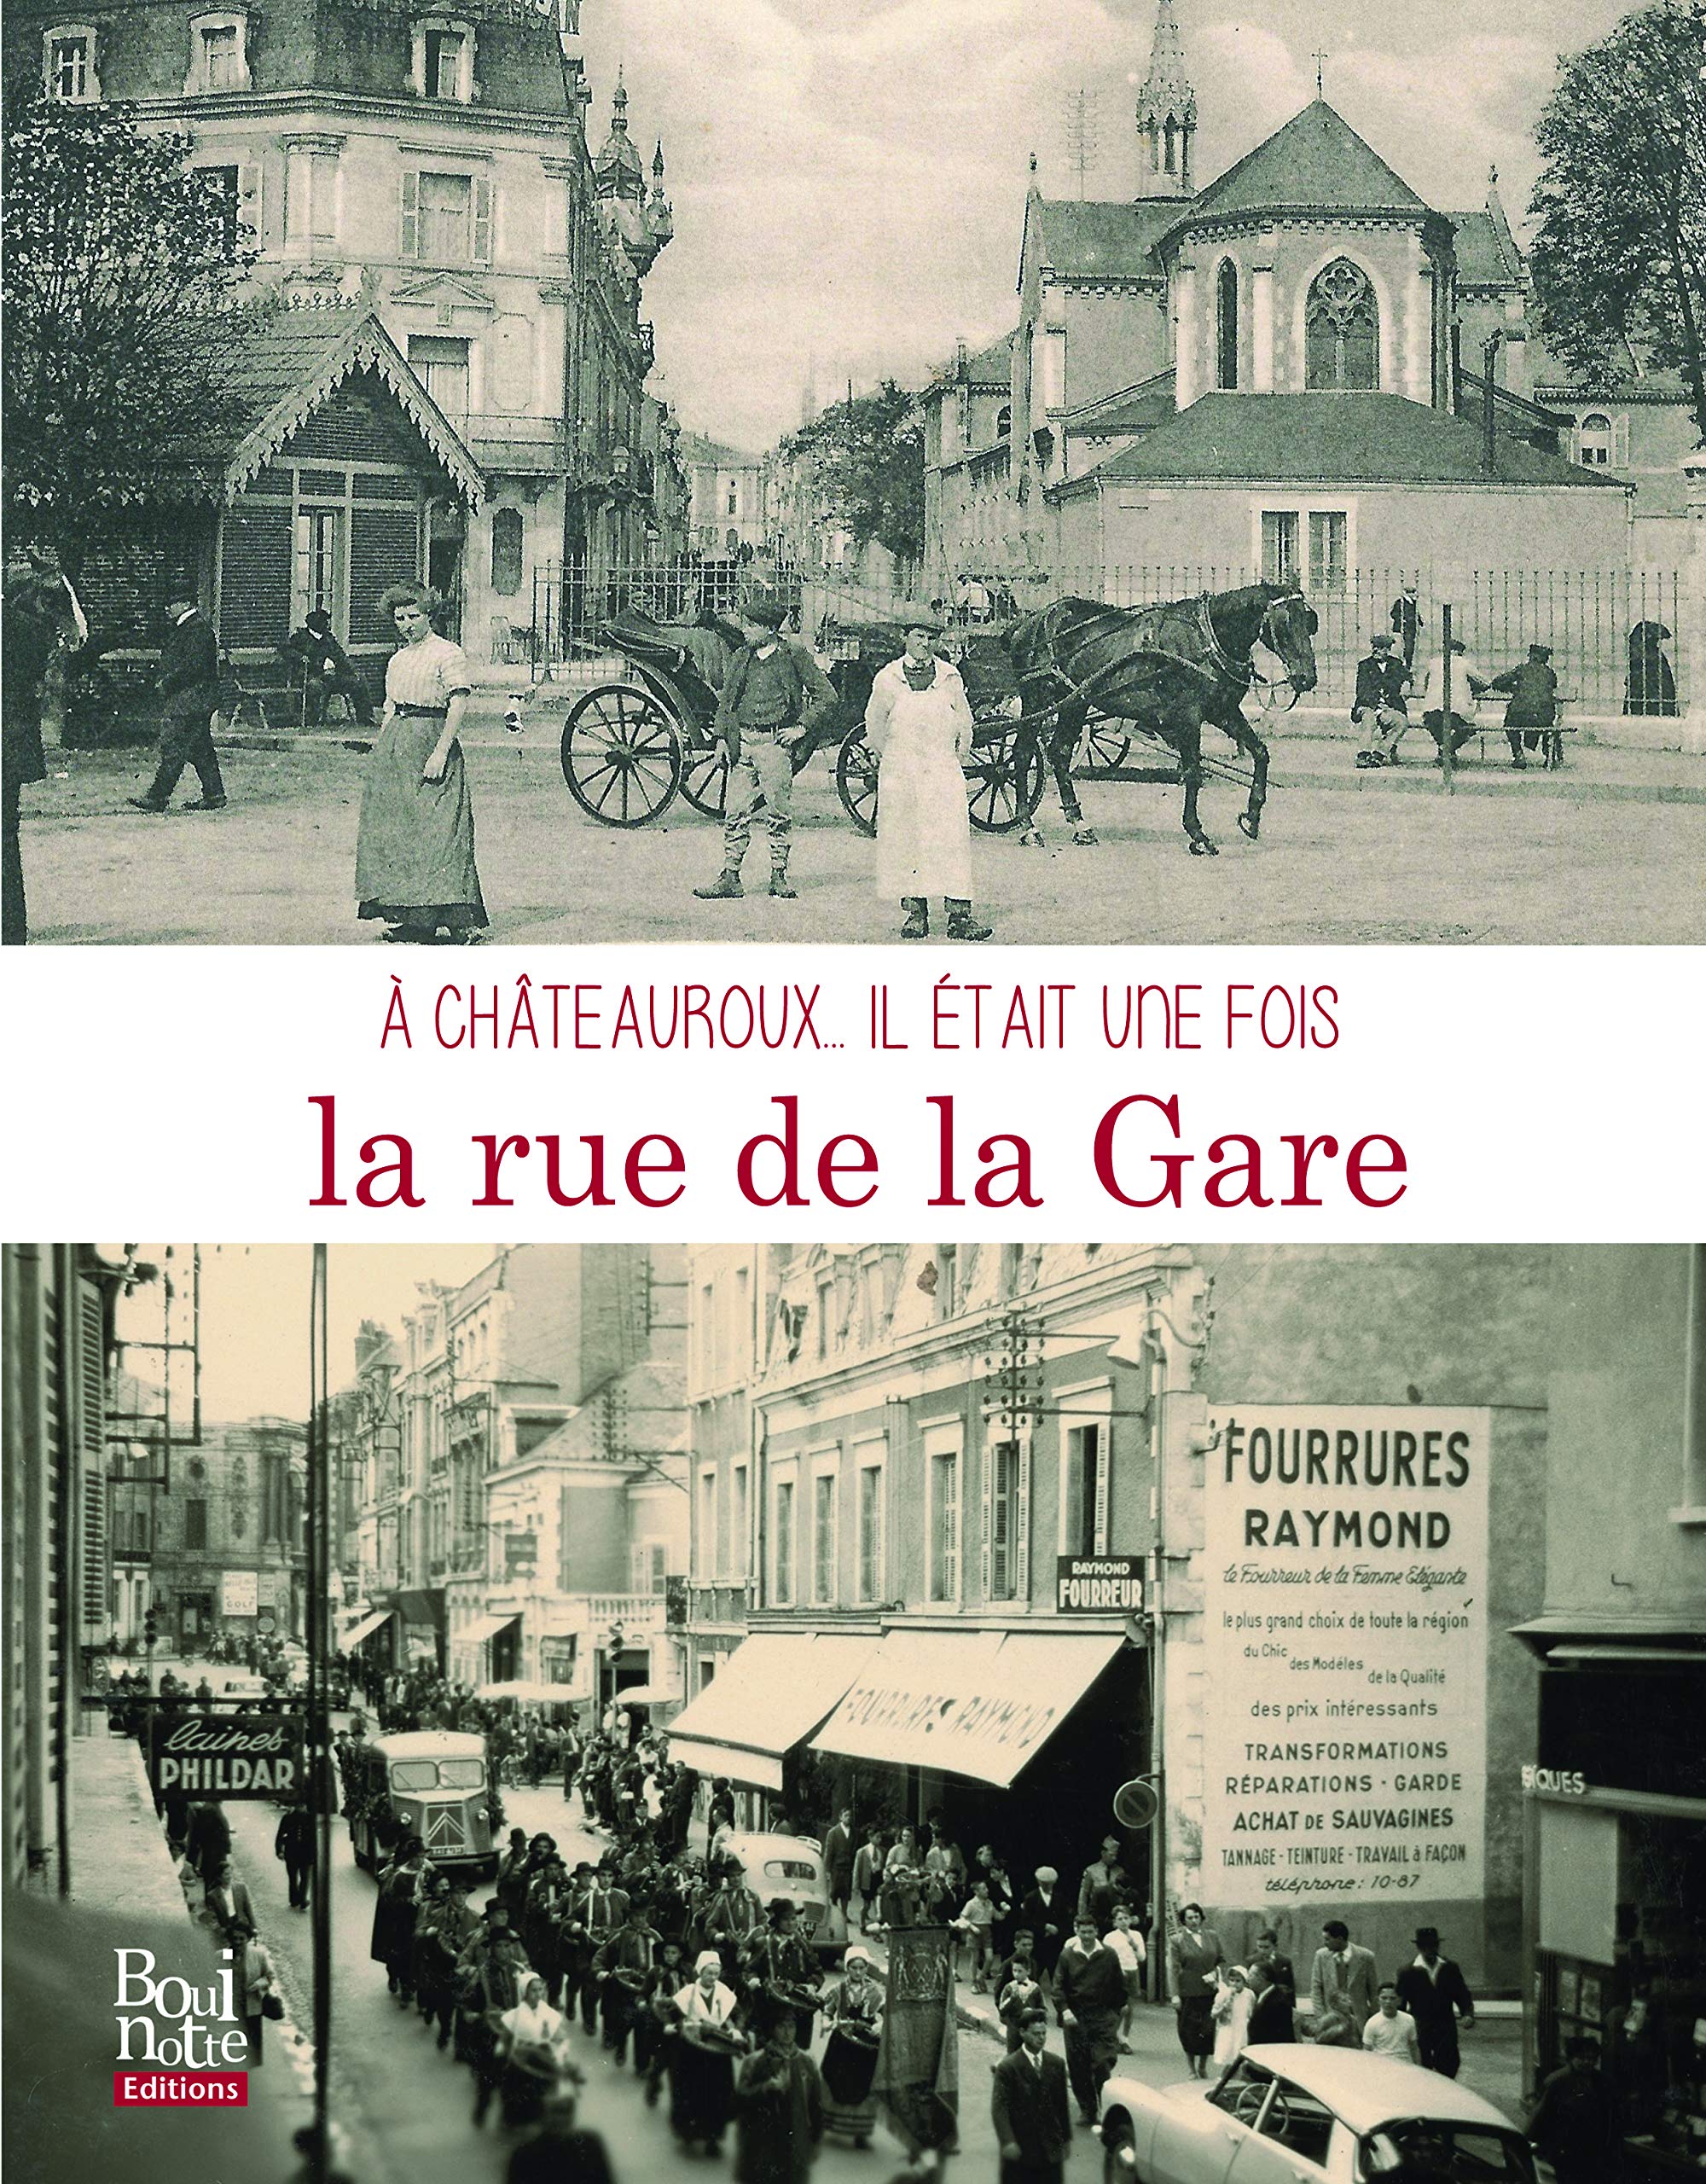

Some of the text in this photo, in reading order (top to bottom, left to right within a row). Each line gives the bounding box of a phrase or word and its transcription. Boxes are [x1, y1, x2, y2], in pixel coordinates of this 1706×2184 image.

[1225, 1425, 1471, 1488] FOURRURES
[1245, 1509, 1451, 1549] RAYMOND
[1071, 1561, 1130, 1575] RAYMOND
[1239, 1563, 1312, 1585] Fourreur
[1314, 1565, 1332, 1585] de
[1333, 1564, 1349, 1584] la
[1352, 1564, 1403, 1586] Femme
[1059, 1579, 1143, 1608] FOURREUR
[1222, 1609, 1470, 1634] le plus grand choix de toute la région
[1243, 1642, 1288, 1658] du Chic
[1289, 1656, 1310, 1670] des
[1367, 1668, 1447, 1687] de la Qualité
[1250, 1698, 1438, 1723] des prix intéressants
[162, 1718, 291, 1751] laines
[1244, 1740, 1449, 1762] TRANSFORMATIONS
[159, 1757, 295, 1791] PHILDAR
[1225, 1774, 1373, 1795] RÉPARATIONS
[1394, 1772, 1463, 1792] GARDE
[1233, 1806, 1455, 1832] ACHAT DE SAUVAGINES
[1221, 1848, 1277, 1867] TANNAGE
[1286, 1846, 1345, 1866] TEINTURE
[1355, 1844, 1410, 1864] TRAVAIL
[1412, 1844, 1422, 1863] à
[1425, 1843, 1468, 1865] FAÇON
[1370, 1873, 1422, 1890] 10-87
